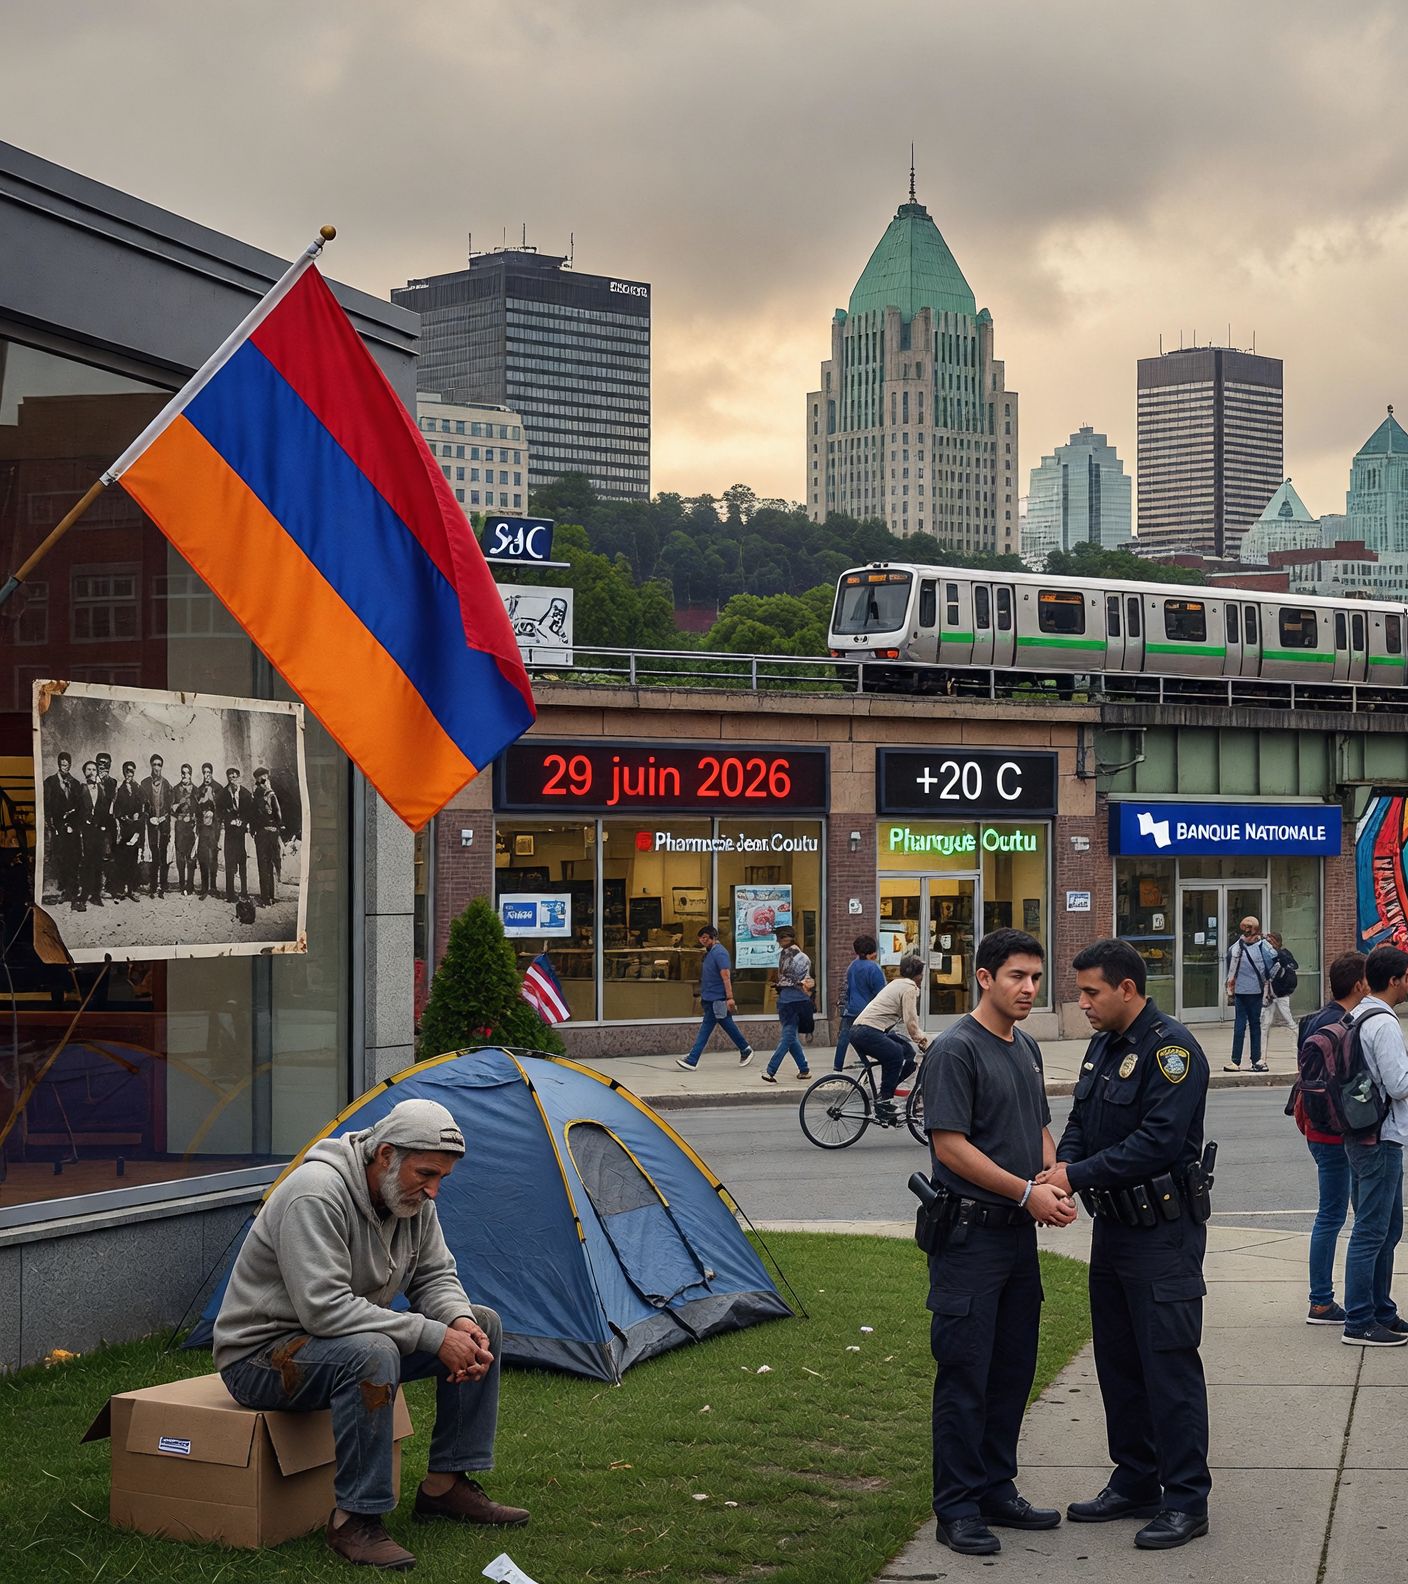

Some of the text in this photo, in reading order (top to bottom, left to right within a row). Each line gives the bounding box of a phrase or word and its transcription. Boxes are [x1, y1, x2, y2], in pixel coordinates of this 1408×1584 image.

[541, 754, 792, 806] 29 juin 2026
[916, 760, 1023, 801] +20 C
[1176, 822, 1327, 842] BANQUE NATIONALE
